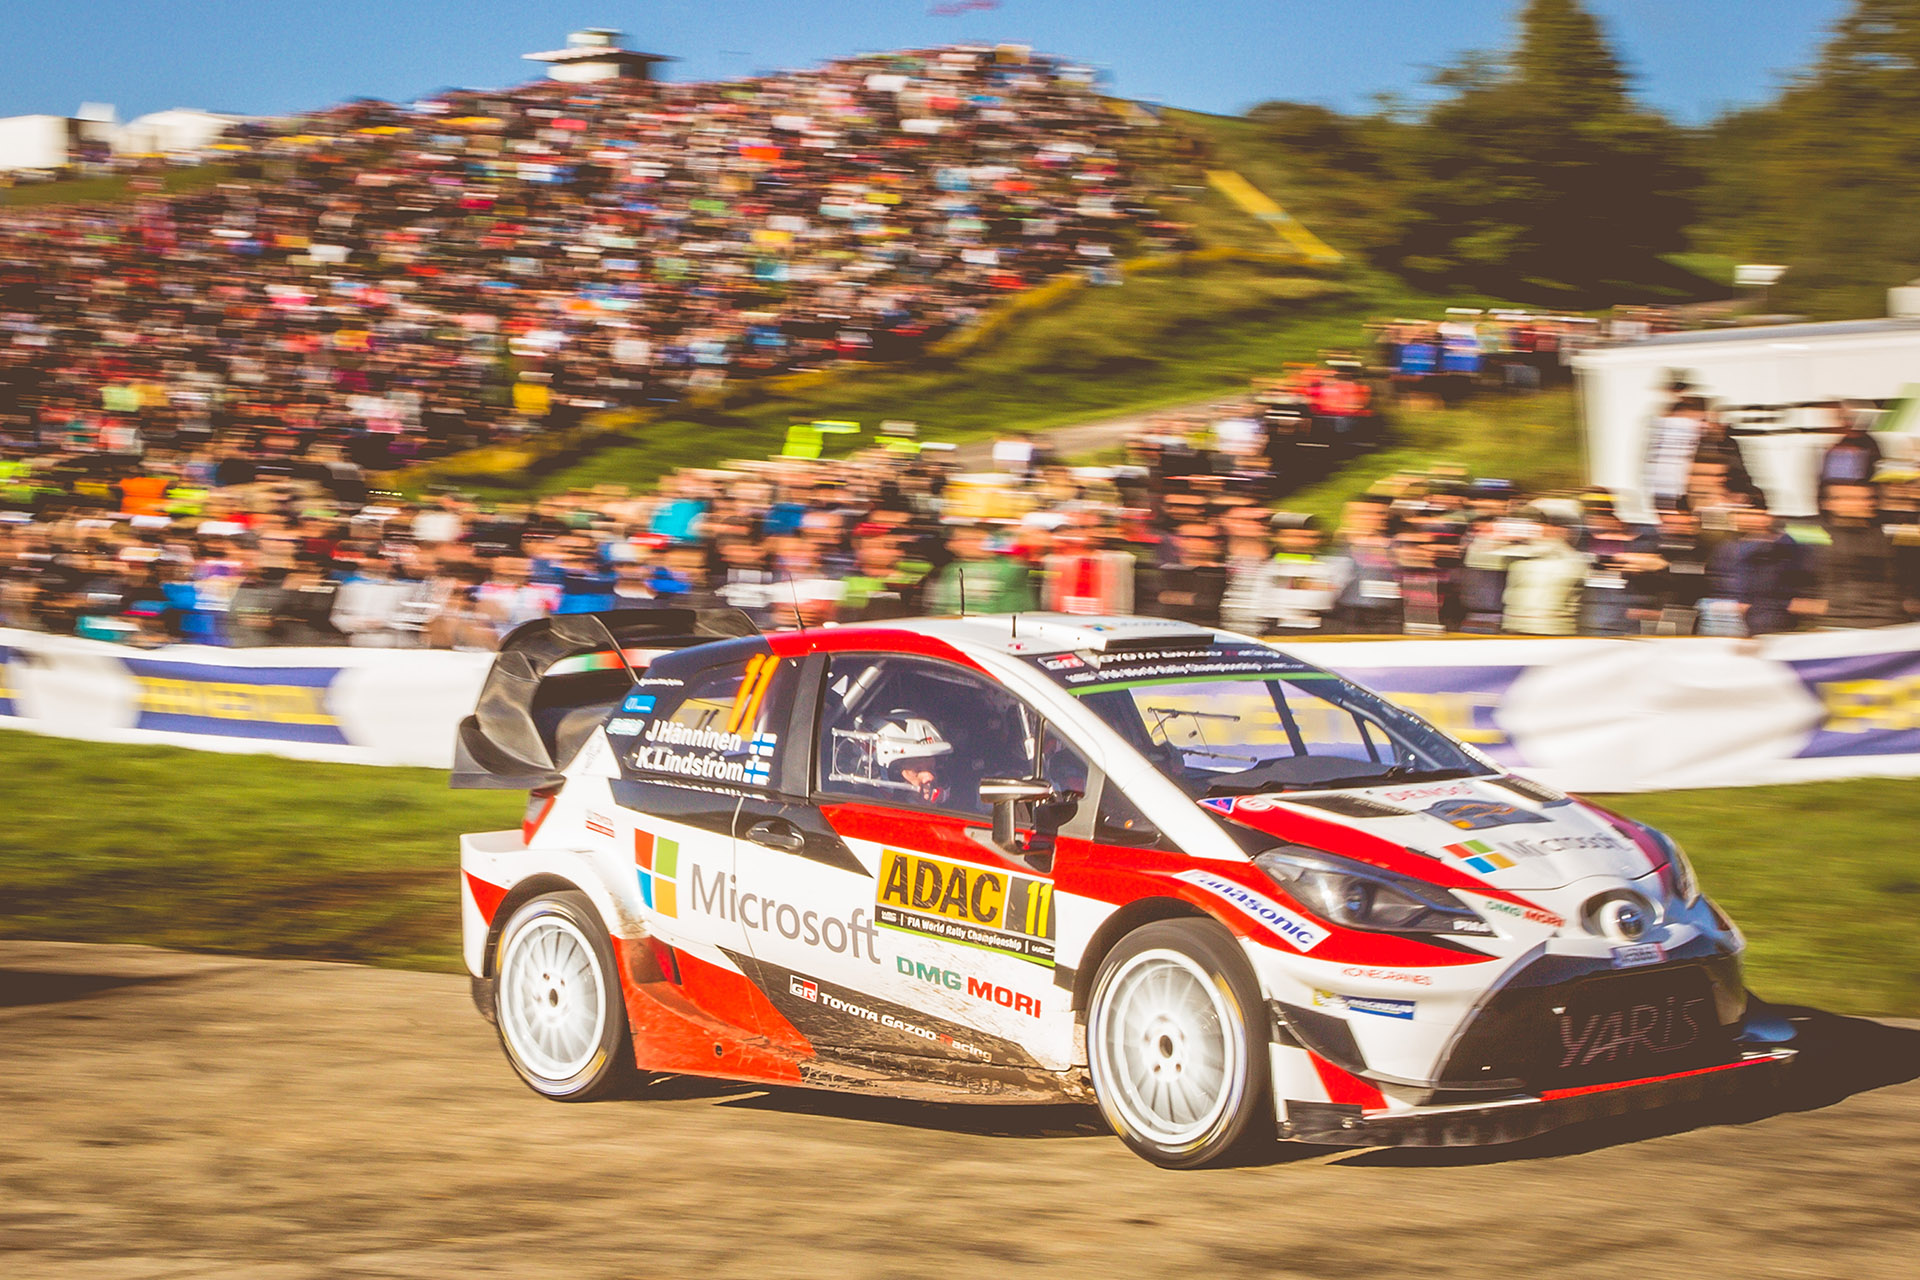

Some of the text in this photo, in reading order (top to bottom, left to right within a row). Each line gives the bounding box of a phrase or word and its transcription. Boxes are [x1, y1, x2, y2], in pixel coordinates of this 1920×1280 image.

[726, 653, 780, 733] 11
[692, 863, 881, 964] Microsoft
[883, 855, 1052, 937] ADAC 11
[907, 917, 920, 928] FIA
[922, 920, 945, 934] World
[946, 925, 966, 940] Rally
[967, 929, 1022, 952] Championship
[791, 983, 992, 1063] GR TOYOTA GAZOO Racing
[896, 956, 1042, 1019] DMG MORI
